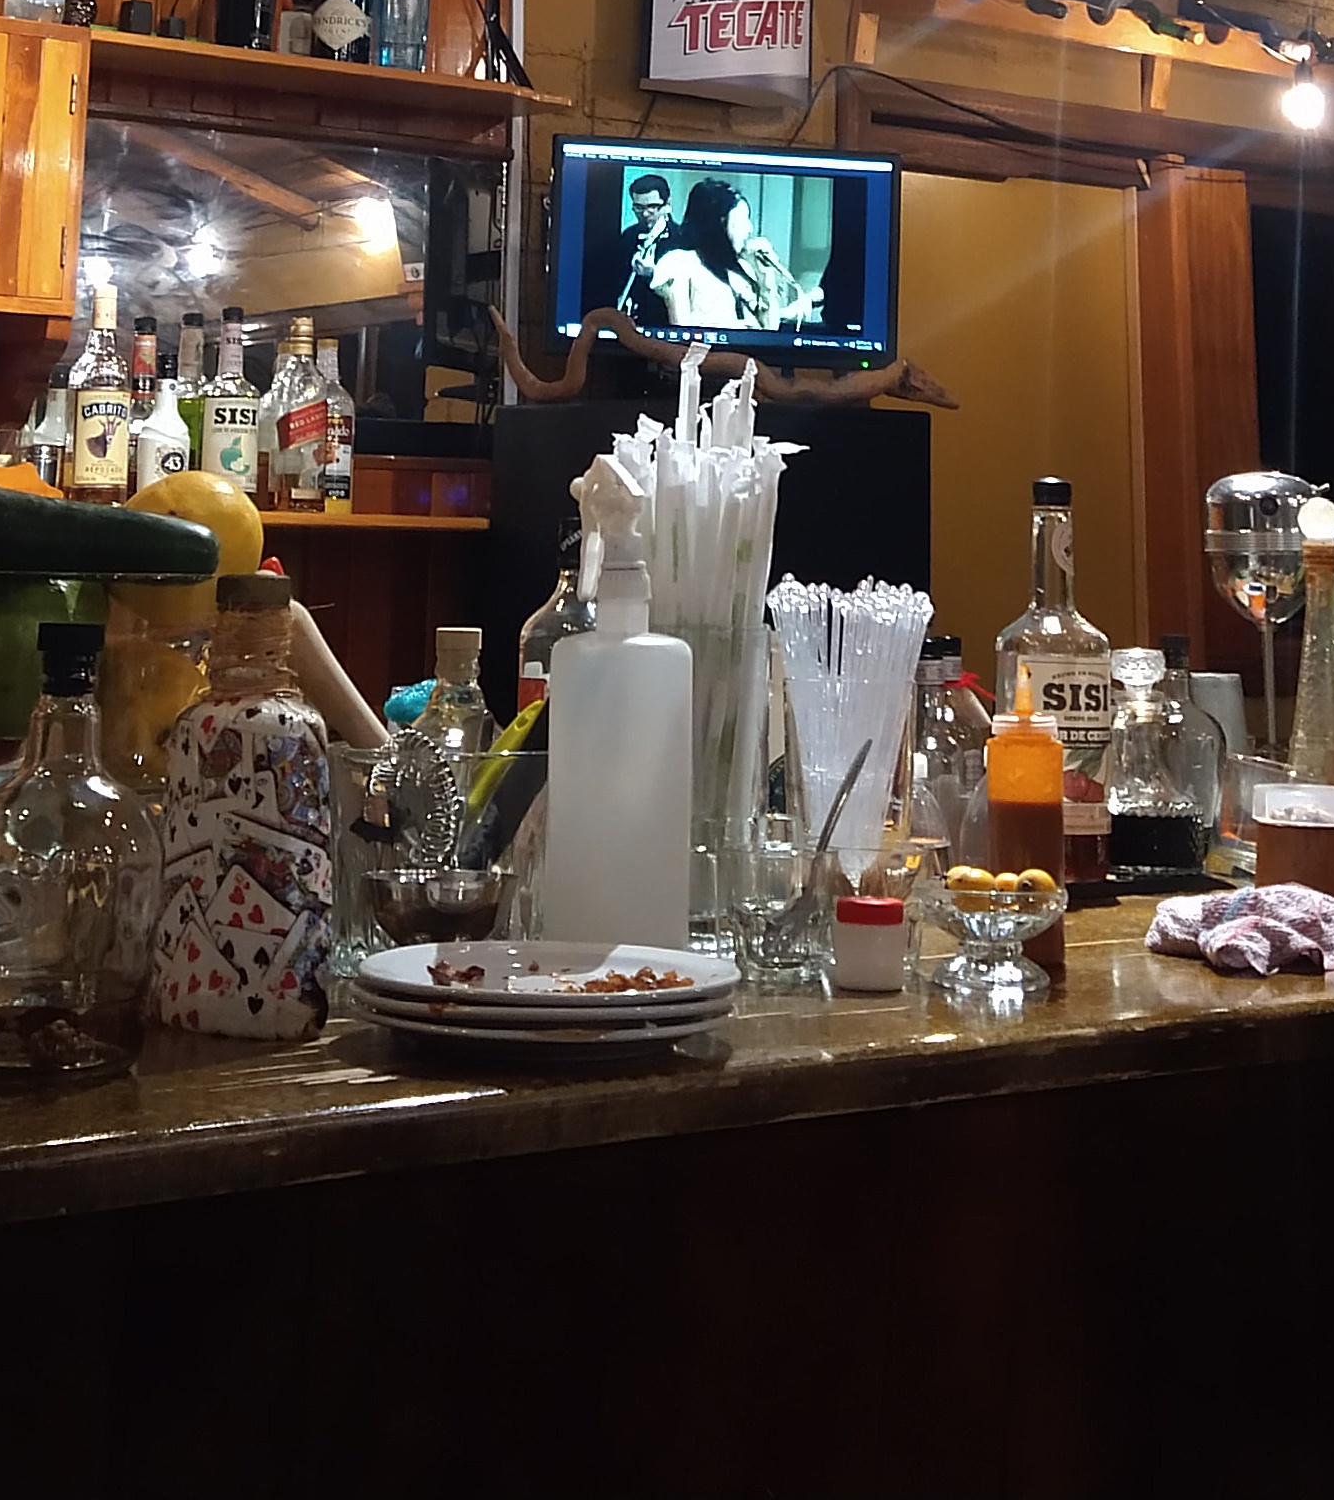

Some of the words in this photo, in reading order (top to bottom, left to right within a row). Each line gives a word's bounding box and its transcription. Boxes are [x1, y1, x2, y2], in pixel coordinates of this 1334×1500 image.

[668, 0, 806, 54] TECATE
[82, 404, 127, 419] CABRITO
[164, 456, 182, 471] 43
